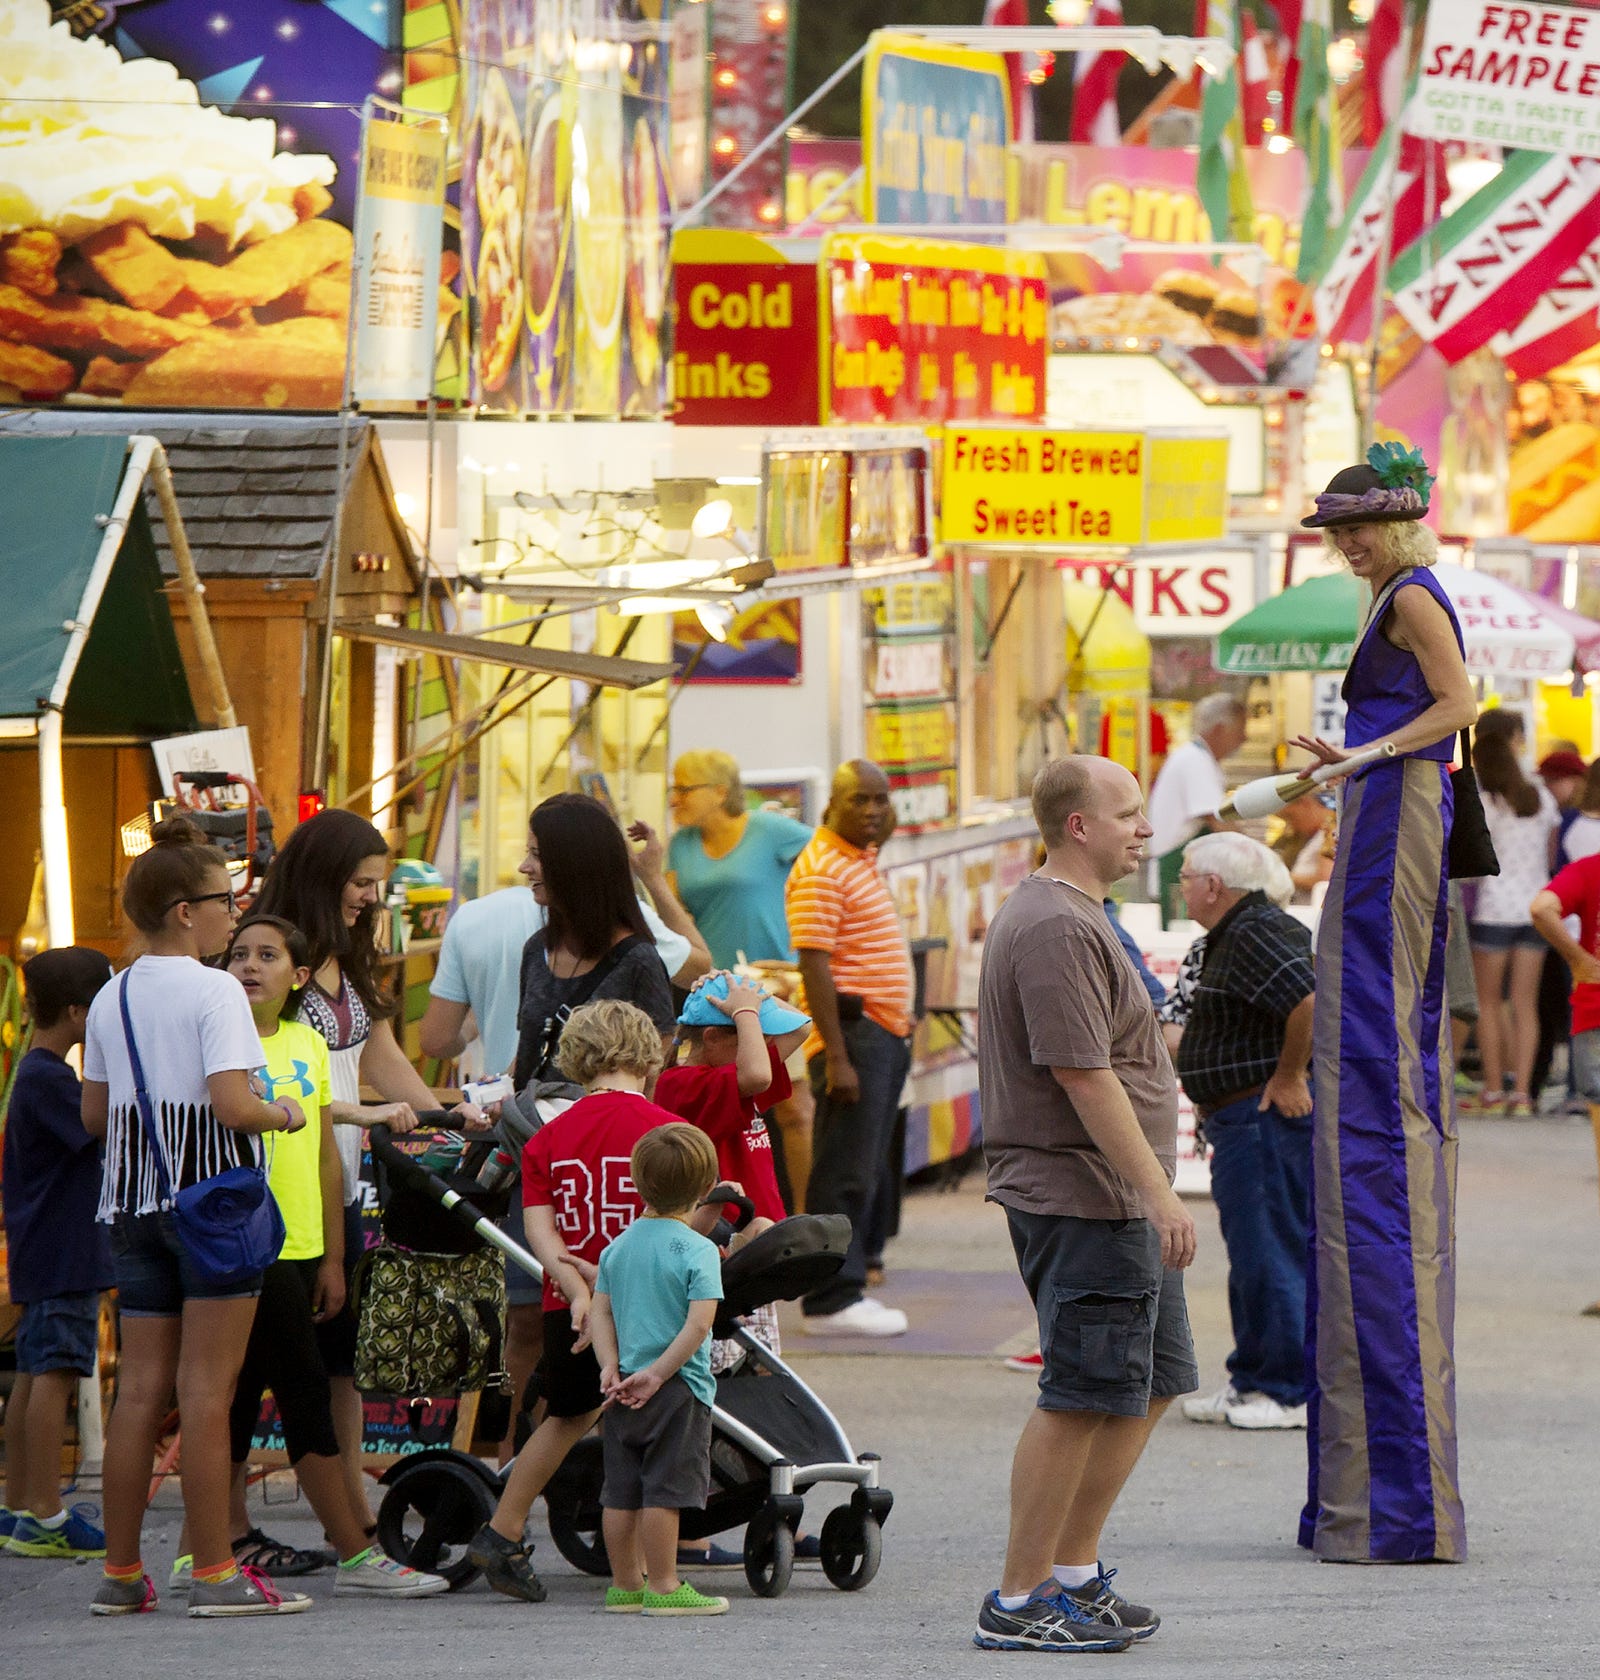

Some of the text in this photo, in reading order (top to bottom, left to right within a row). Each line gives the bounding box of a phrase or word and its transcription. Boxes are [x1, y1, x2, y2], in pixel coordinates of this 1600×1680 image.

[1479, 6, 1589, 48] FREE
[1426, 89, 1505, 113] GOTTA
[1516, 100, 1587, 126] TASTE
[1434, 114, 1465, 133] TO
[1472, 119, 1564, 146] BELIEVE
[689, 281, 792, 329] Cold
[954, 435, 1140, 476] Fresh Brewed
[974, 498, 1057, 535] Sweet
[1068, 500, 1111, 536] Tea
[550, 1156, 645, 1251] 35
